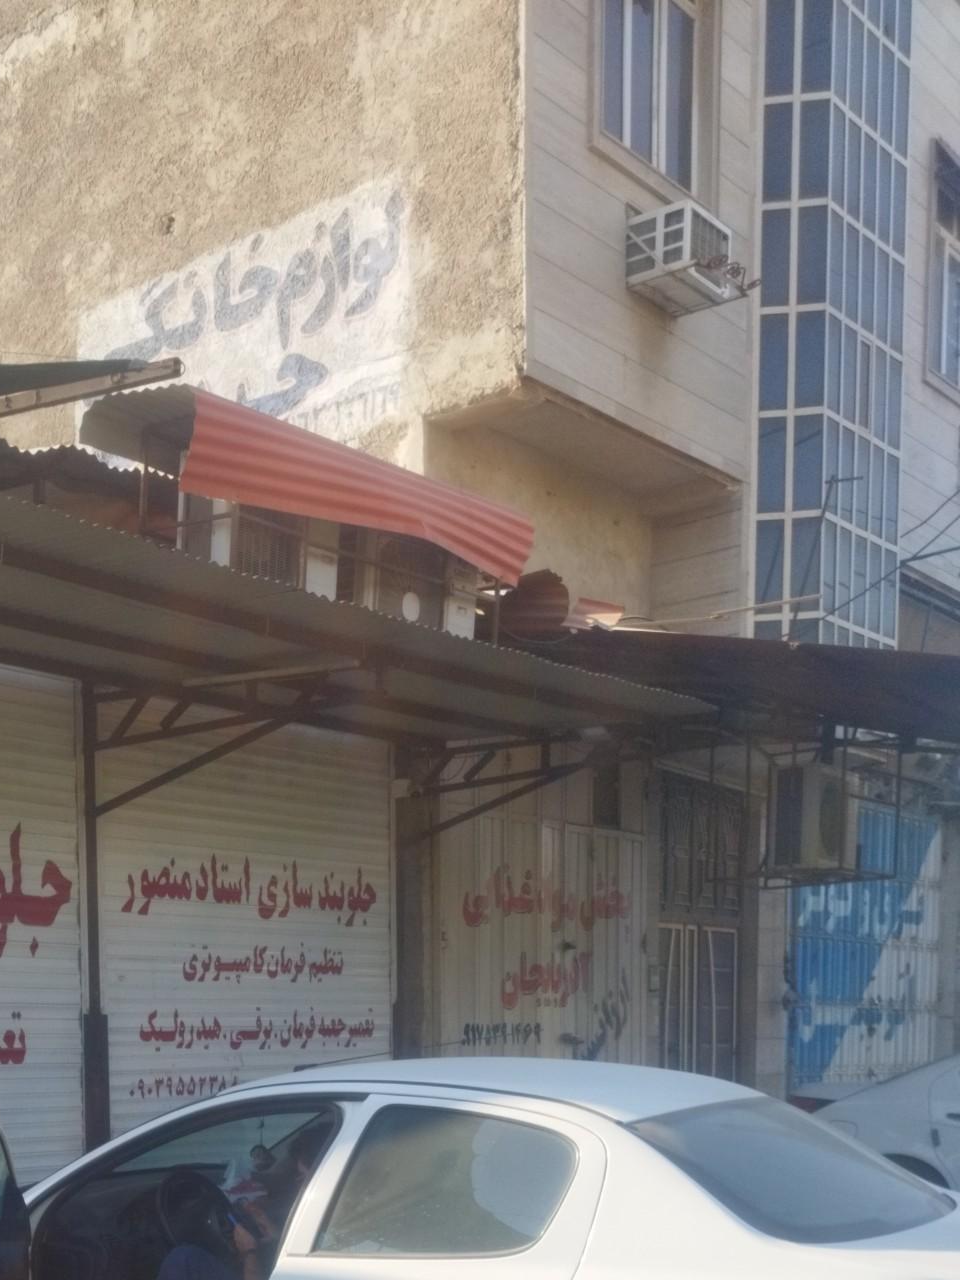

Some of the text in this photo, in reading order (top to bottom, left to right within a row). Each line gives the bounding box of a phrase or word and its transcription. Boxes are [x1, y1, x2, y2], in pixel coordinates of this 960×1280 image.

[276, 188, 405, 351] لوازم
[121, 857, 193, 916] منصور
[195, 853, 252, 905] استاد
[267, 942, 306, 983] فرمان
